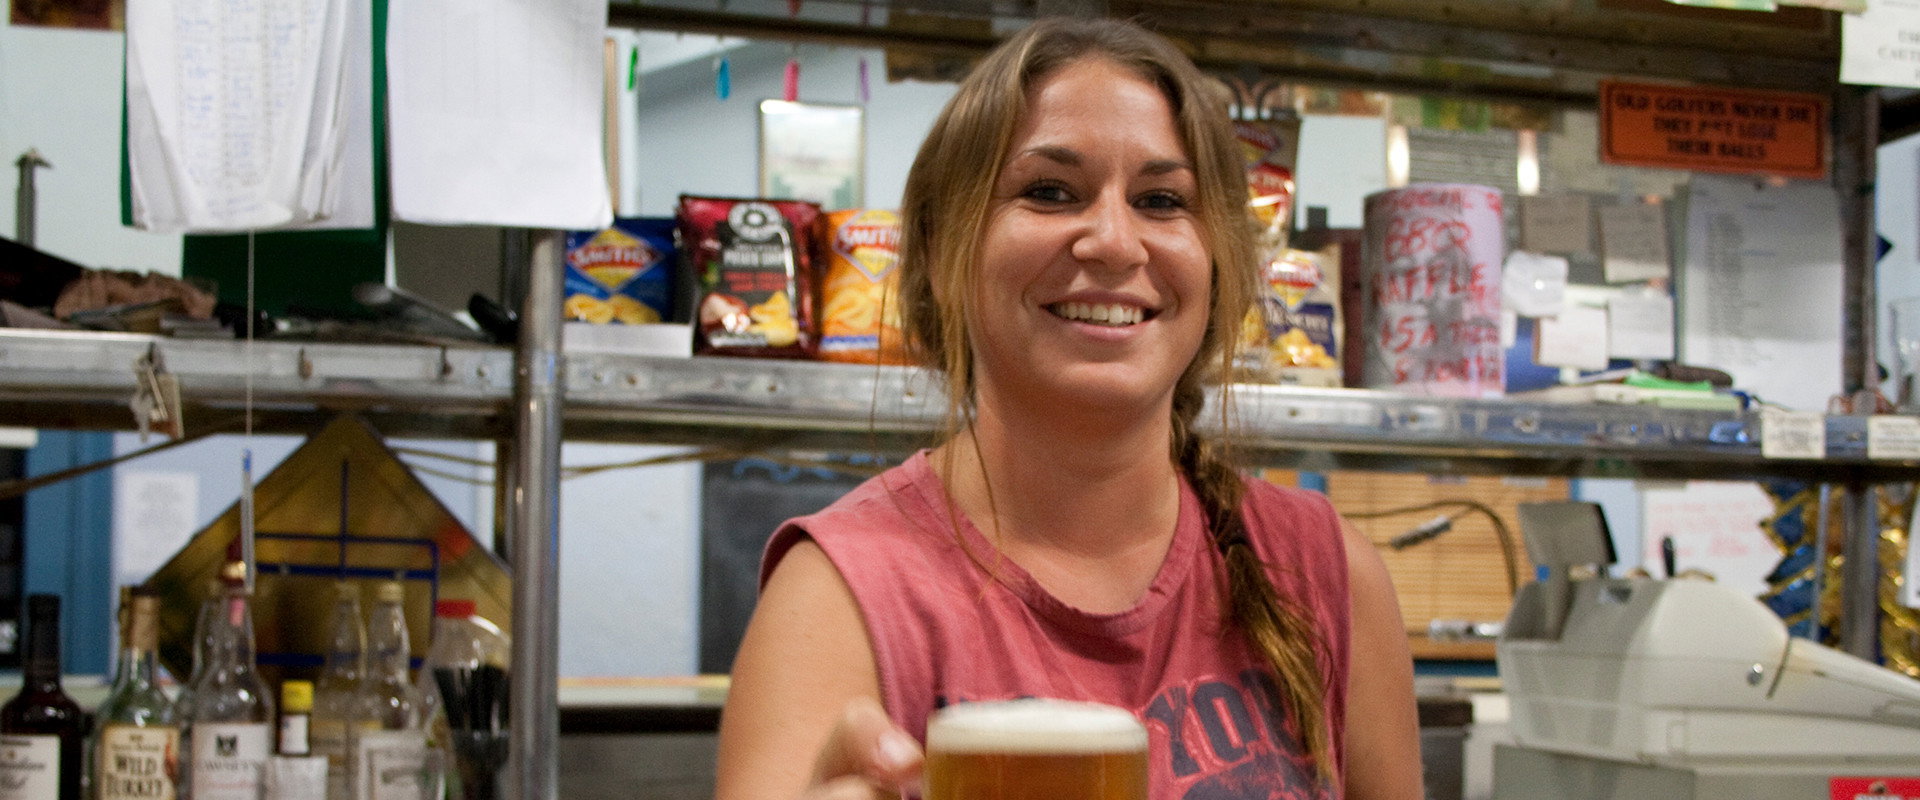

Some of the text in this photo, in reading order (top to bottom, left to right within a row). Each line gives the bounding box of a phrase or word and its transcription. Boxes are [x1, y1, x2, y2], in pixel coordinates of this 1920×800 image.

[1615, 92, 1649, 110] OLD
[1144, 668, 1312, 777] YOR
[115, 755, 158, 776] WILD
[105, 774, 163, 798] TURKEY
